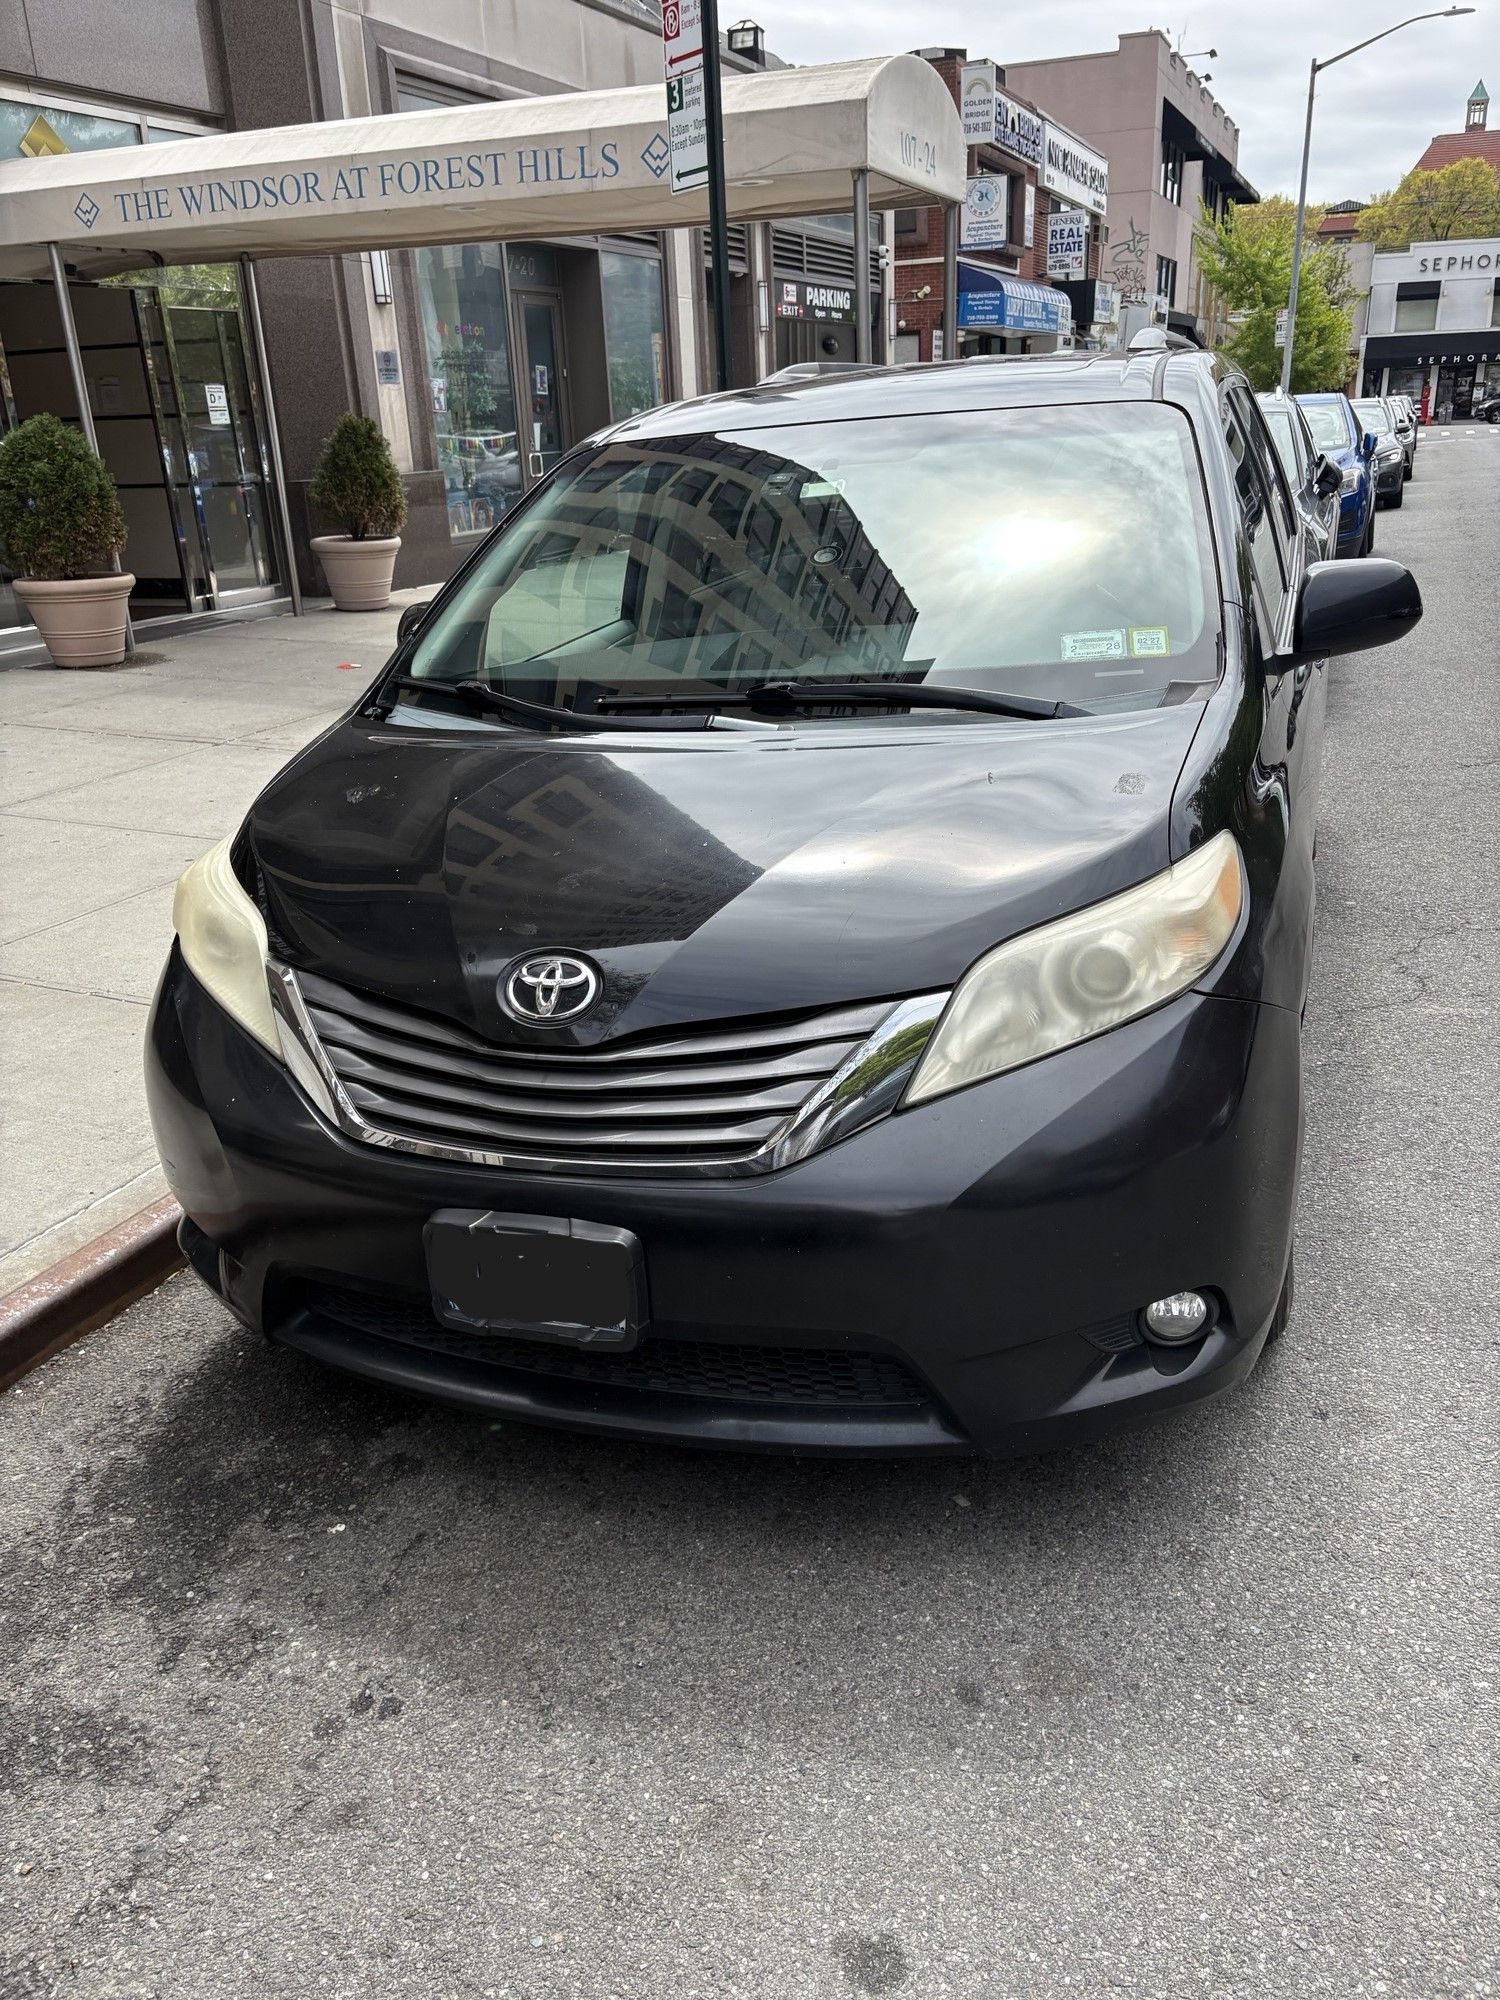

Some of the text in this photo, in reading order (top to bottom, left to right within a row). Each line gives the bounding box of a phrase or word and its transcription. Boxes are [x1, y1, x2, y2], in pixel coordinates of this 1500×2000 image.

[671, 80, 680, 110] 3
[963, 98, 992, 107] GOLDEN
[965, 110, 991, 119] BRIDGE
[671, 133, 706, 152] Except Sunday
[900, 131, 936, 177] 107-24
[114, 142, 619, 222] THE WINDSOR AT FOREST HILLS
[1049, 216, 1084, 227] GENERAL
[1051, 227, 1083, 240] REAL
[1049, 241, 1083, 254] ESTATE
[806, 286, 851, 310] PARKING
[782, 304, 798, 316] EXIT
[1417, 353, 1500, 365] SEPHORA
[1106, 642, 1121, 651] 28
